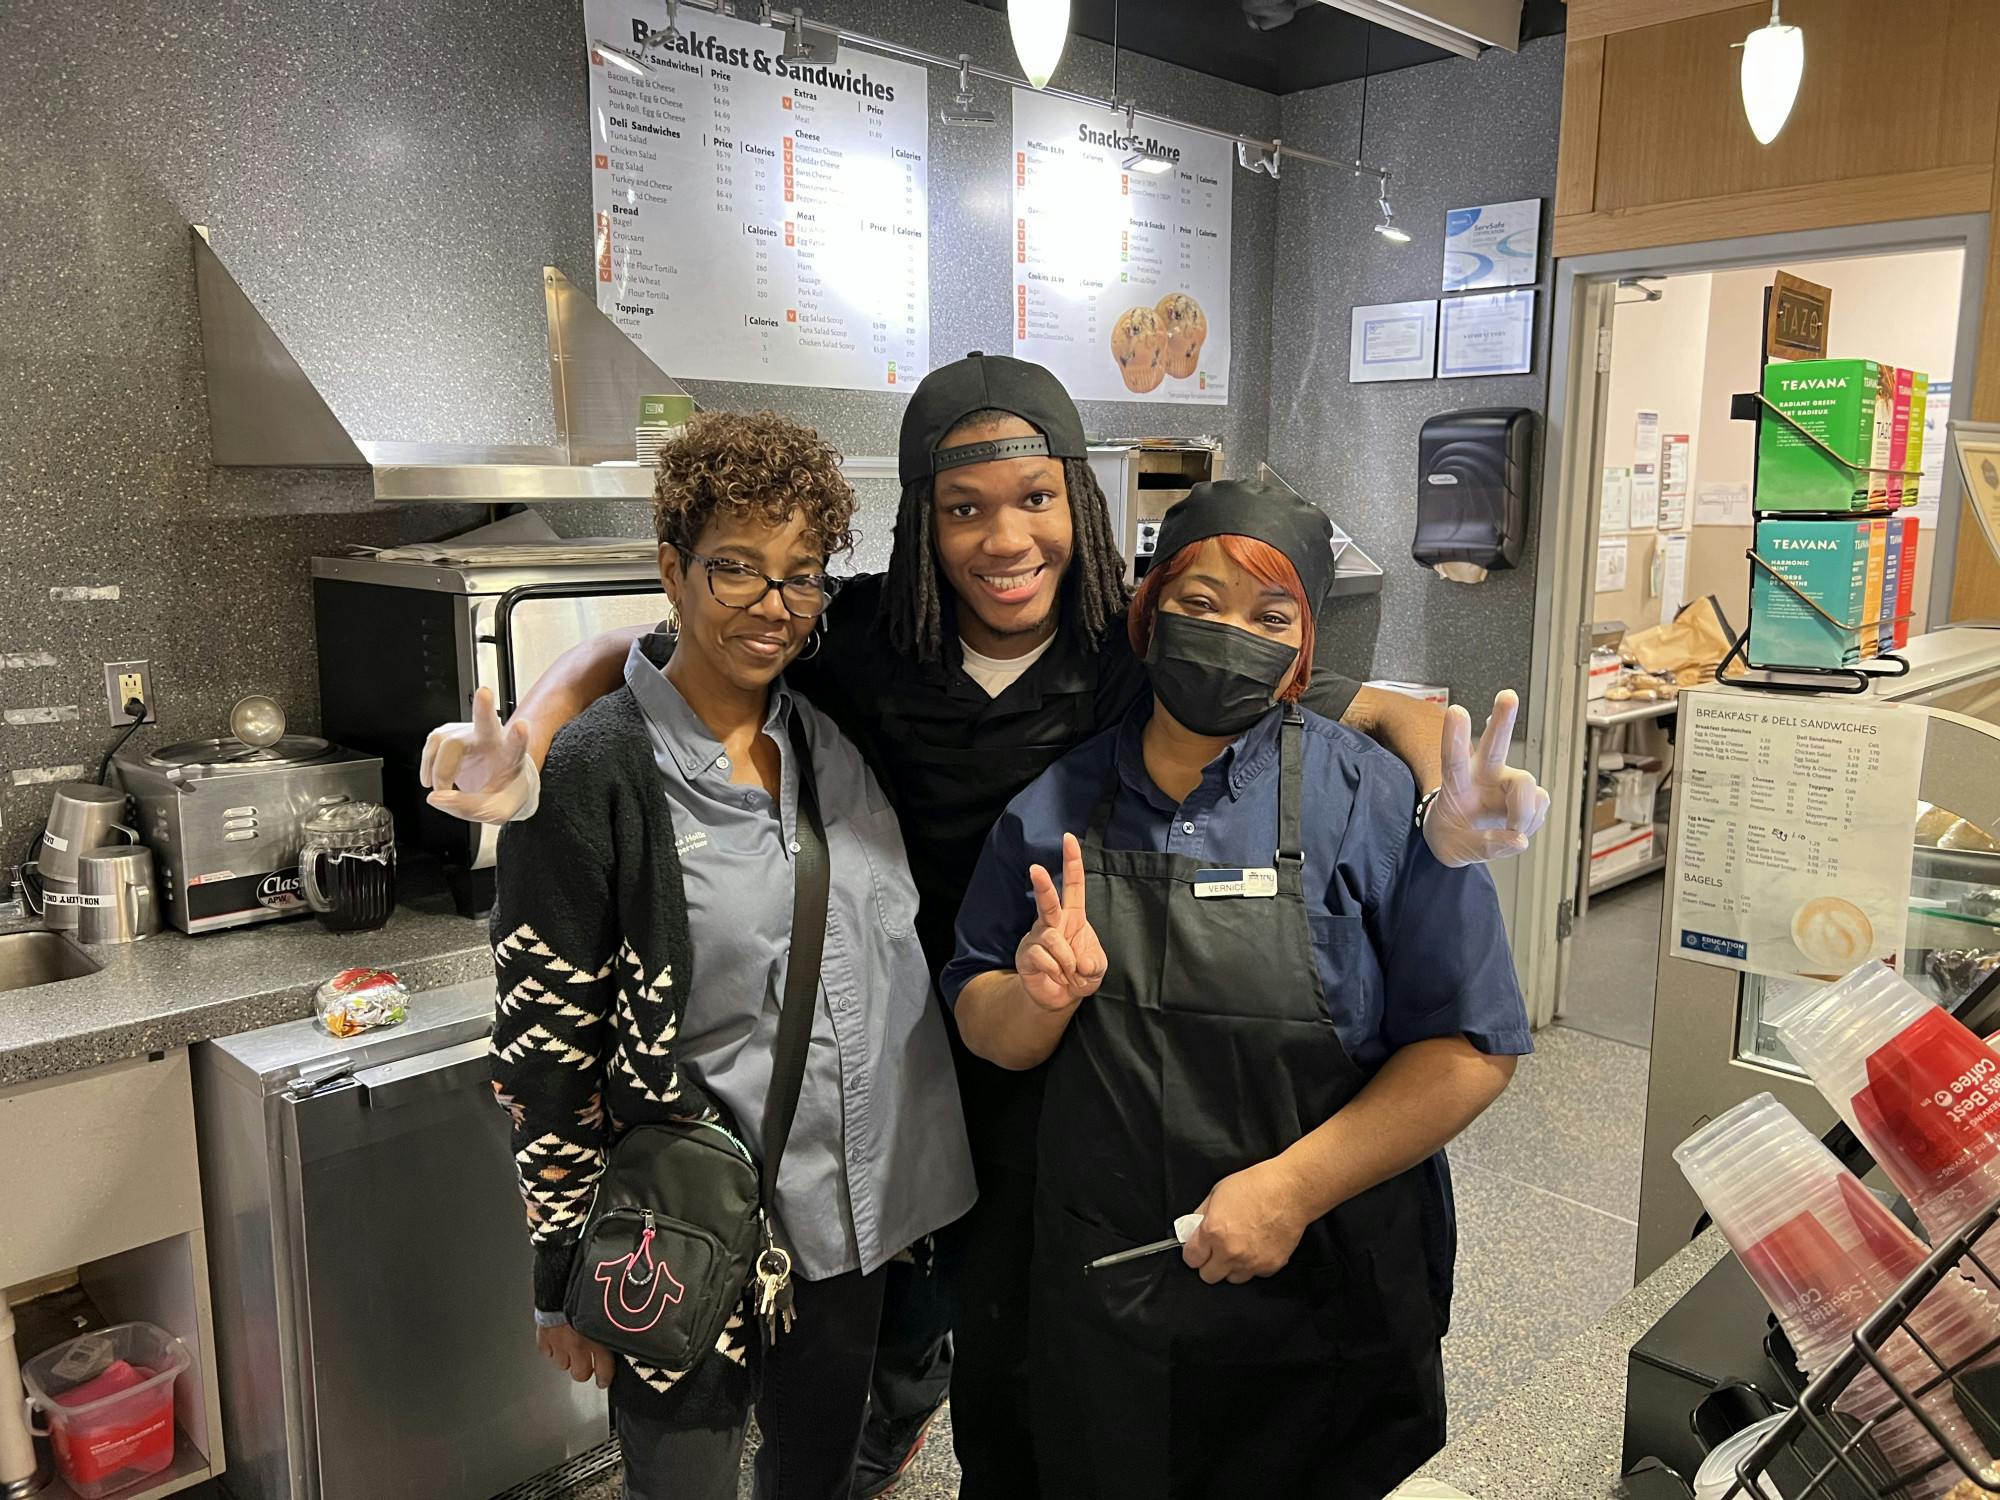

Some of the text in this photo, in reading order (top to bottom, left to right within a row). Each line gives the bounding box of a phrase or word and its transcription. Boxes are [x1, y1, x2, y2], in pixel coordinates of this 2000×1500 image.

[651, 54, 700, 74] Sandwiches
[710, 69, 732, 82] Price
[607, 71, 630, 84] Bacon,
[631, 76, 644, 88] Egg
[652, 81, 676, 93] Cheese
[753, 50, 772, 76] &
[776, 54, 895, 101] Sandwiches
[608, 85, 638, 100] Sausage,
[640, 92, 652, 103] Egg
[659, 96, 684, 109] Cheese
[794, 88, 884, 116] Extras Price
[609, 100, 624, 110] Pork
[642, 107, 655, 118] Egg
[662, 111, 686, 123] Cheese
[794, 101, 815, 112] Cheese
[609, 117, 681, 139] Deli Sandwiches
[610, 131, 647, 145] Tuna Salad
[795, 129, 921, 161] Cheese Calories
[1079, 123, 1180, 162] Snacks More
[610, 145, 657, 161] Chicken Salad
[713, 137, 775, 157] Price Calories
[610, 160, 644, 172] Egg Salad
[611, 174, 635, 186] Turkey
[636, 178, 648, 187] and
[649, 180, 673, 191] Cheese
[643, 193, 667, 204] Cheese
[612, 204, 639, 216] Bread
[612, 217, 632, 227] Bagel
[796, 211, 922, 238] Meat Price Calories
[747, 225, 777, 237] Calories
[636, 261, 677, 274] Flour Tortilla
[638, 277, 661, 286] Wheat
[628, 289, 670, 300] Flour Tortilla
[615, 302, 779, 327] Toppings Calories
[615, 316, 641, 326] Lettuce
[1783, 302, 1819, 339] TAZO
[798, 338, 822, 347] Chicken
[1781, 377, 1847, 391] TEAVANA
[1773, 539, 1838, 550] TEAVANA
[1695, 723, 1720, 731] Breakfast
[1696, 708, 1877, 735] BREAKFAST & DELI SANDWICHES
[1808, 783, 1834, 792] Toppings
[1684, 872, 1723, 888] BAGELS
[1208, 884, 1246, 893] VERNICE
[84, 897, 100, 905] NON
[267, 894, 287, 905] APW
[1701, 936, 1745, 949] EDUCATION
[1949, 1058, 1996, 1094] Coffee
[1946, 1090, 1989, 1123] Best
